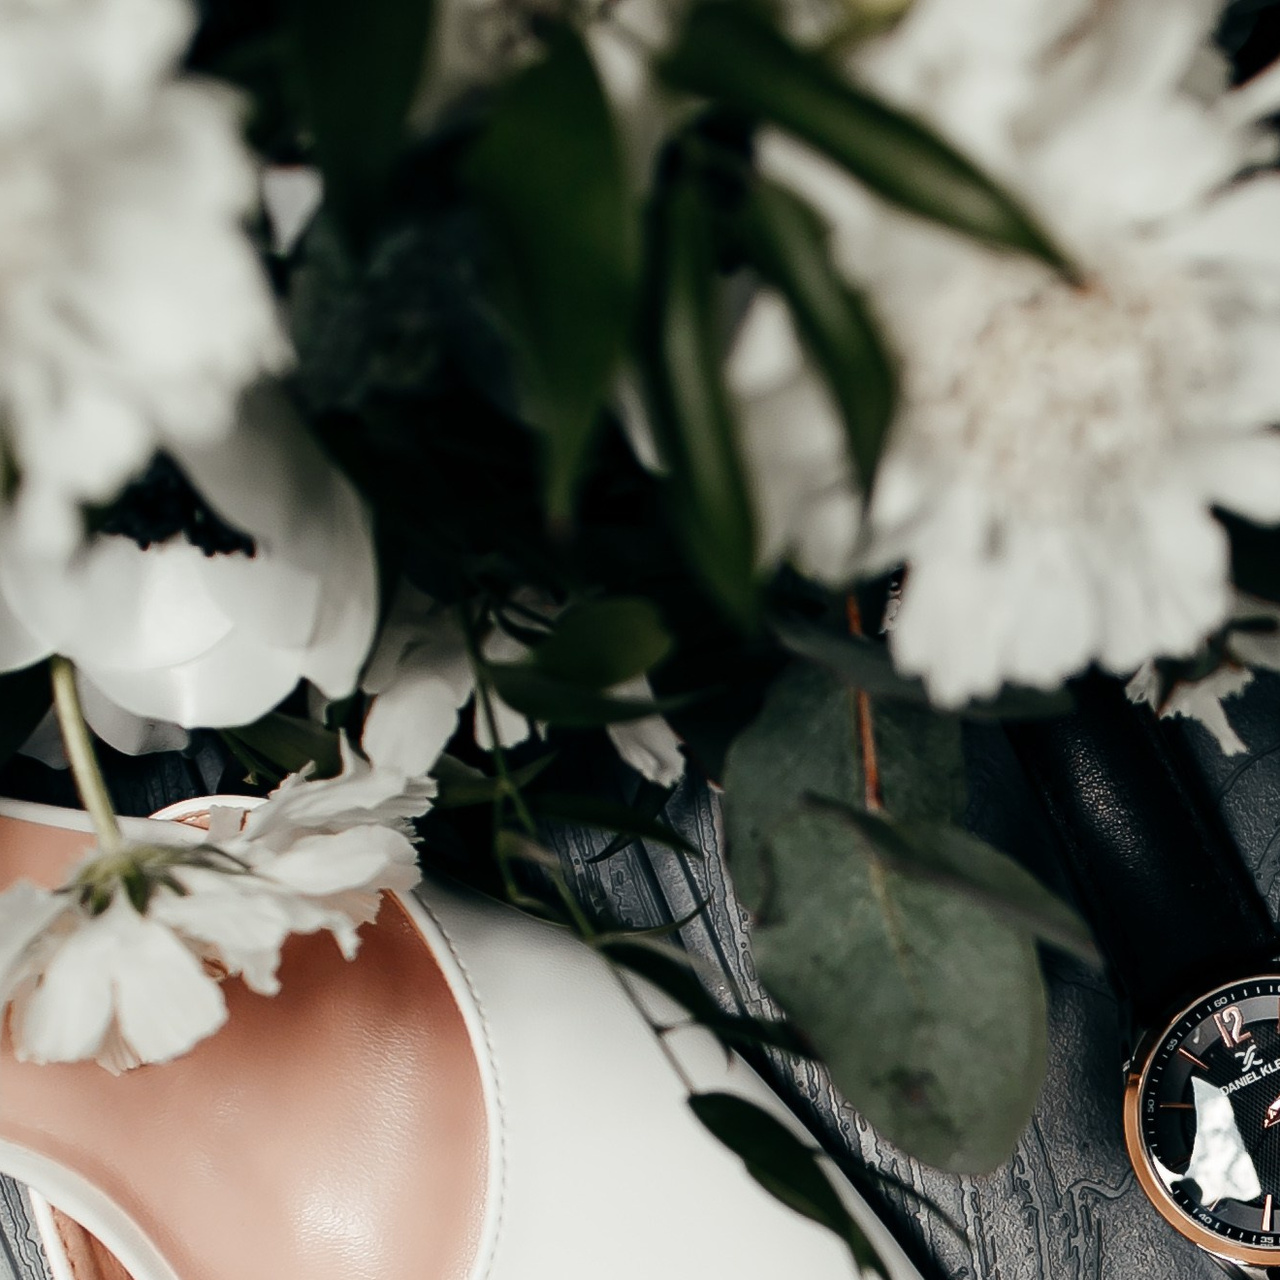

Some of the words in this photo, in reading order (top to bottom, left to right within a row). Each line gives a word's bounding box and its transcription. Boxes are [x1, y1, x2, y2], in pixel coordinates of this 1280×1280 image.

[1213, 997, 1228, 1008] 60
[1213, 1005, 1252, 1049] 12
[1166, 1038, 1178, 1051] 55
[1218, 1071, 1263, 1096] DANIEL
[1147, 1098, 1155, 1113] 50
[1198, 1213, 1213, 1225] 40
[1260, 1236, 1274, 1244] 35
